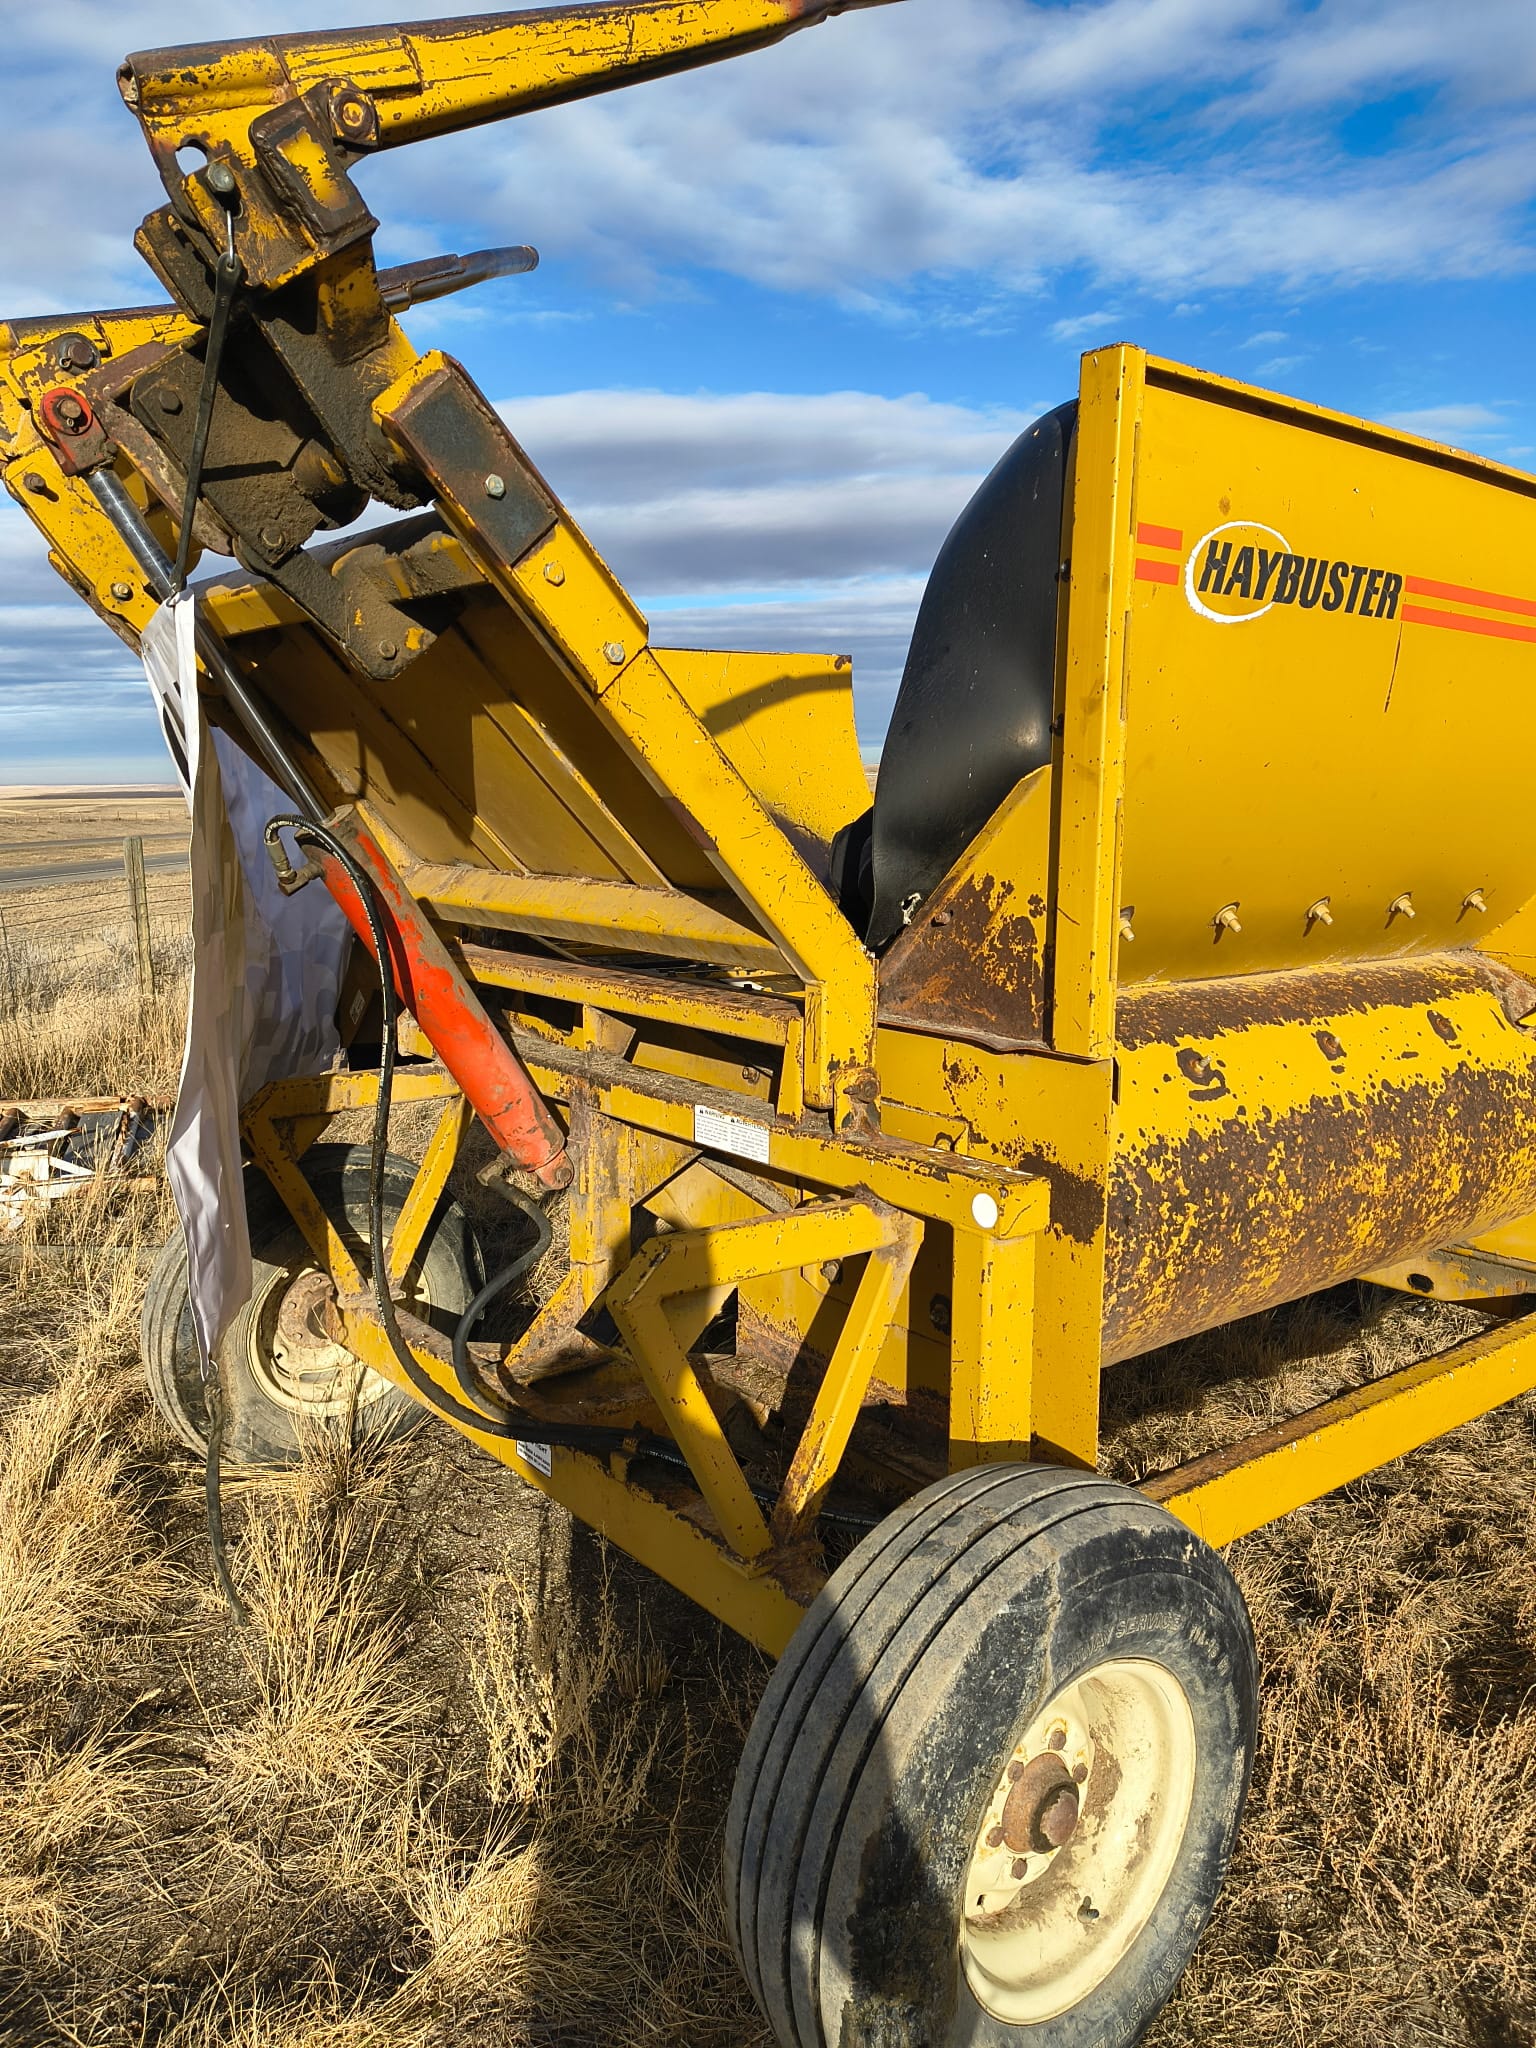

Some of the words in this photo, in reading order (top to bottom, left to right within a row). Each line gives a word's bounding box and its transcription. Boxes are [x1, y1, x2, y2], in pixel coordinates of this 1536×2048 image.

[1198, 539, 1403, 620] HAYBUSTER
[1115, 1610, 1182, 1639] SERVICE
[1114, 1903, 1207, 2046] HARVEST
